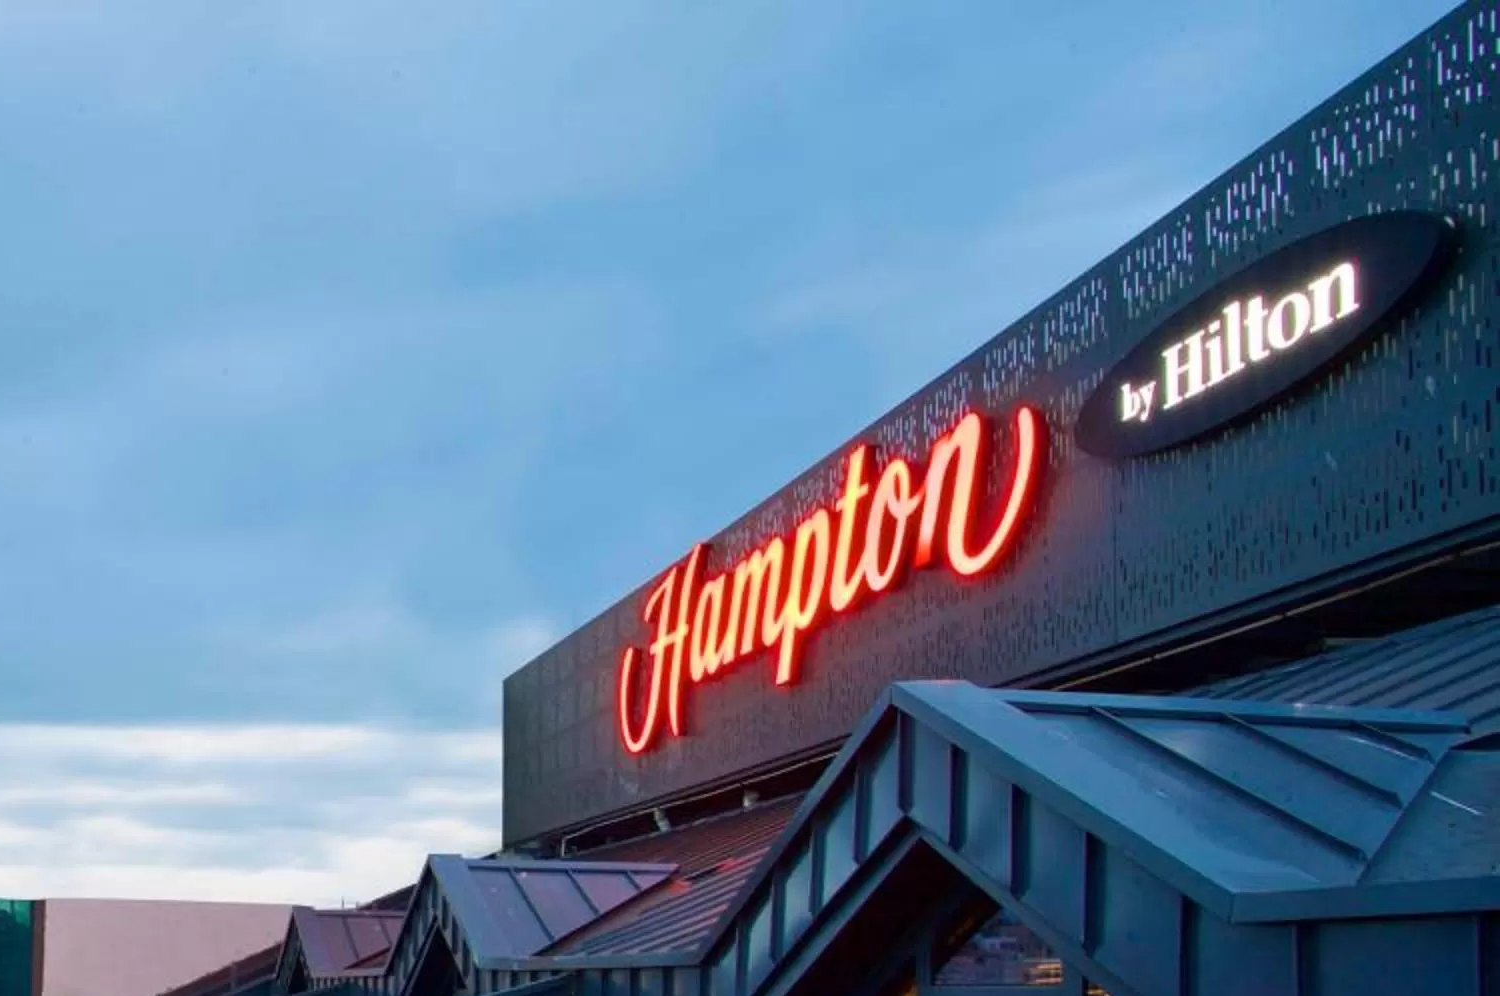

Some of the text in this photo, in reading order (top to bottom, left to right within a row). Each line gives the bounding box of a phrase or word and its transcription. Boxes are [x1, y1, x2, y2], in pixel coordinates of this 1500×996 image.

[1120, 261, 1361, 423] by Hilton
[618, 405, 1040, 755] Hampton
